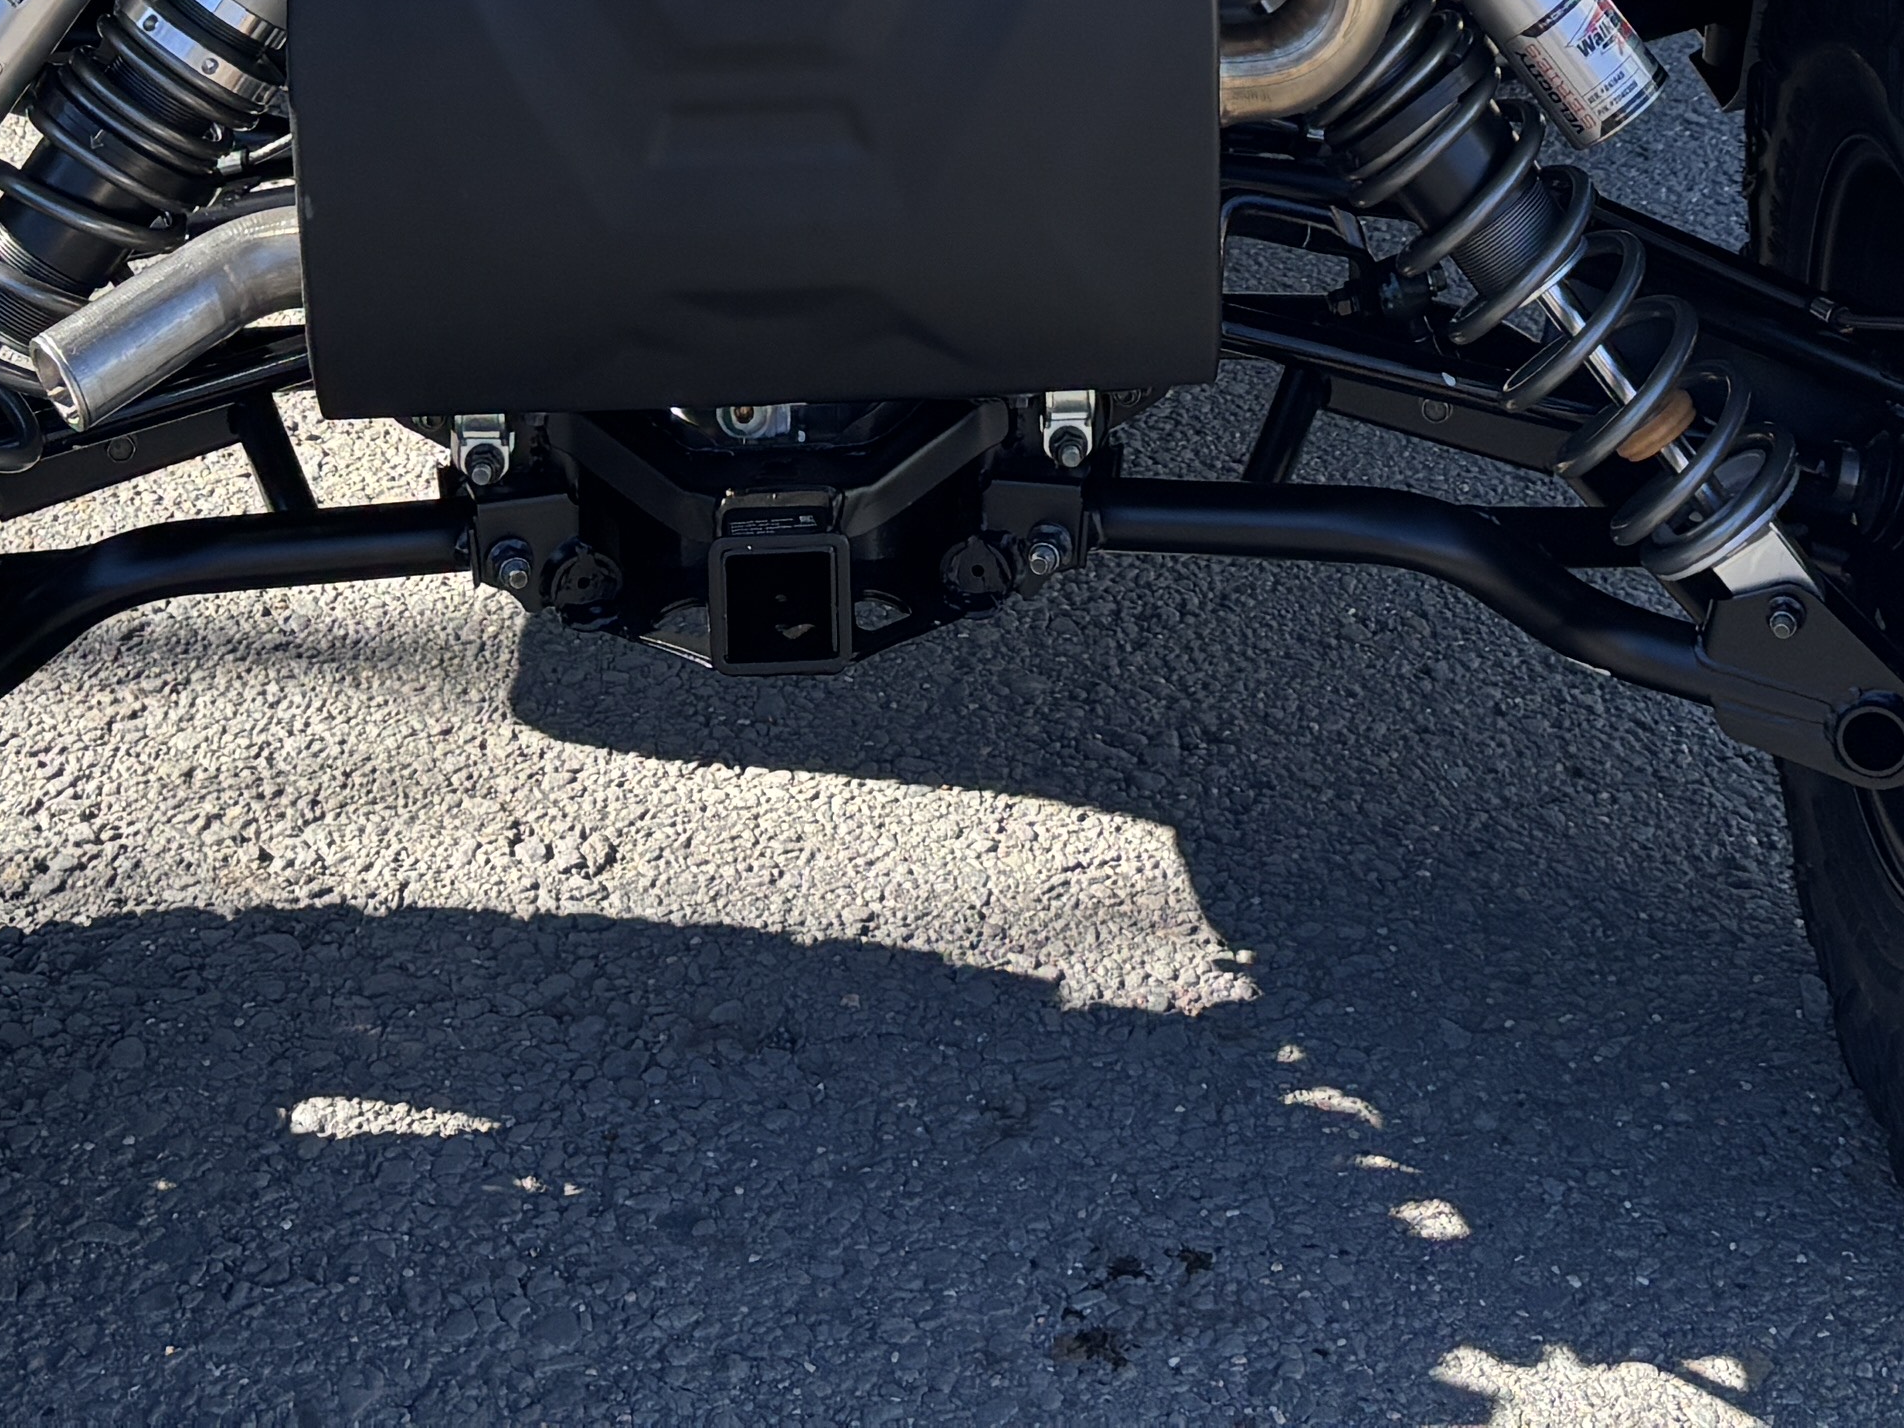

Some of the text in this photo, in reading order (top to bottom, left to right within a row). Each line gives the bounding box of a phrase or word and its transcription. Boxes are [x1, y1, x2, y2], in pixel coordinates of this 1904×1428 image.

[1577, 8, 1621, 58] Walke
[1514, 51, 1585, 135] VELOCITY
[1525, 44, 1597, 130] SERIES
